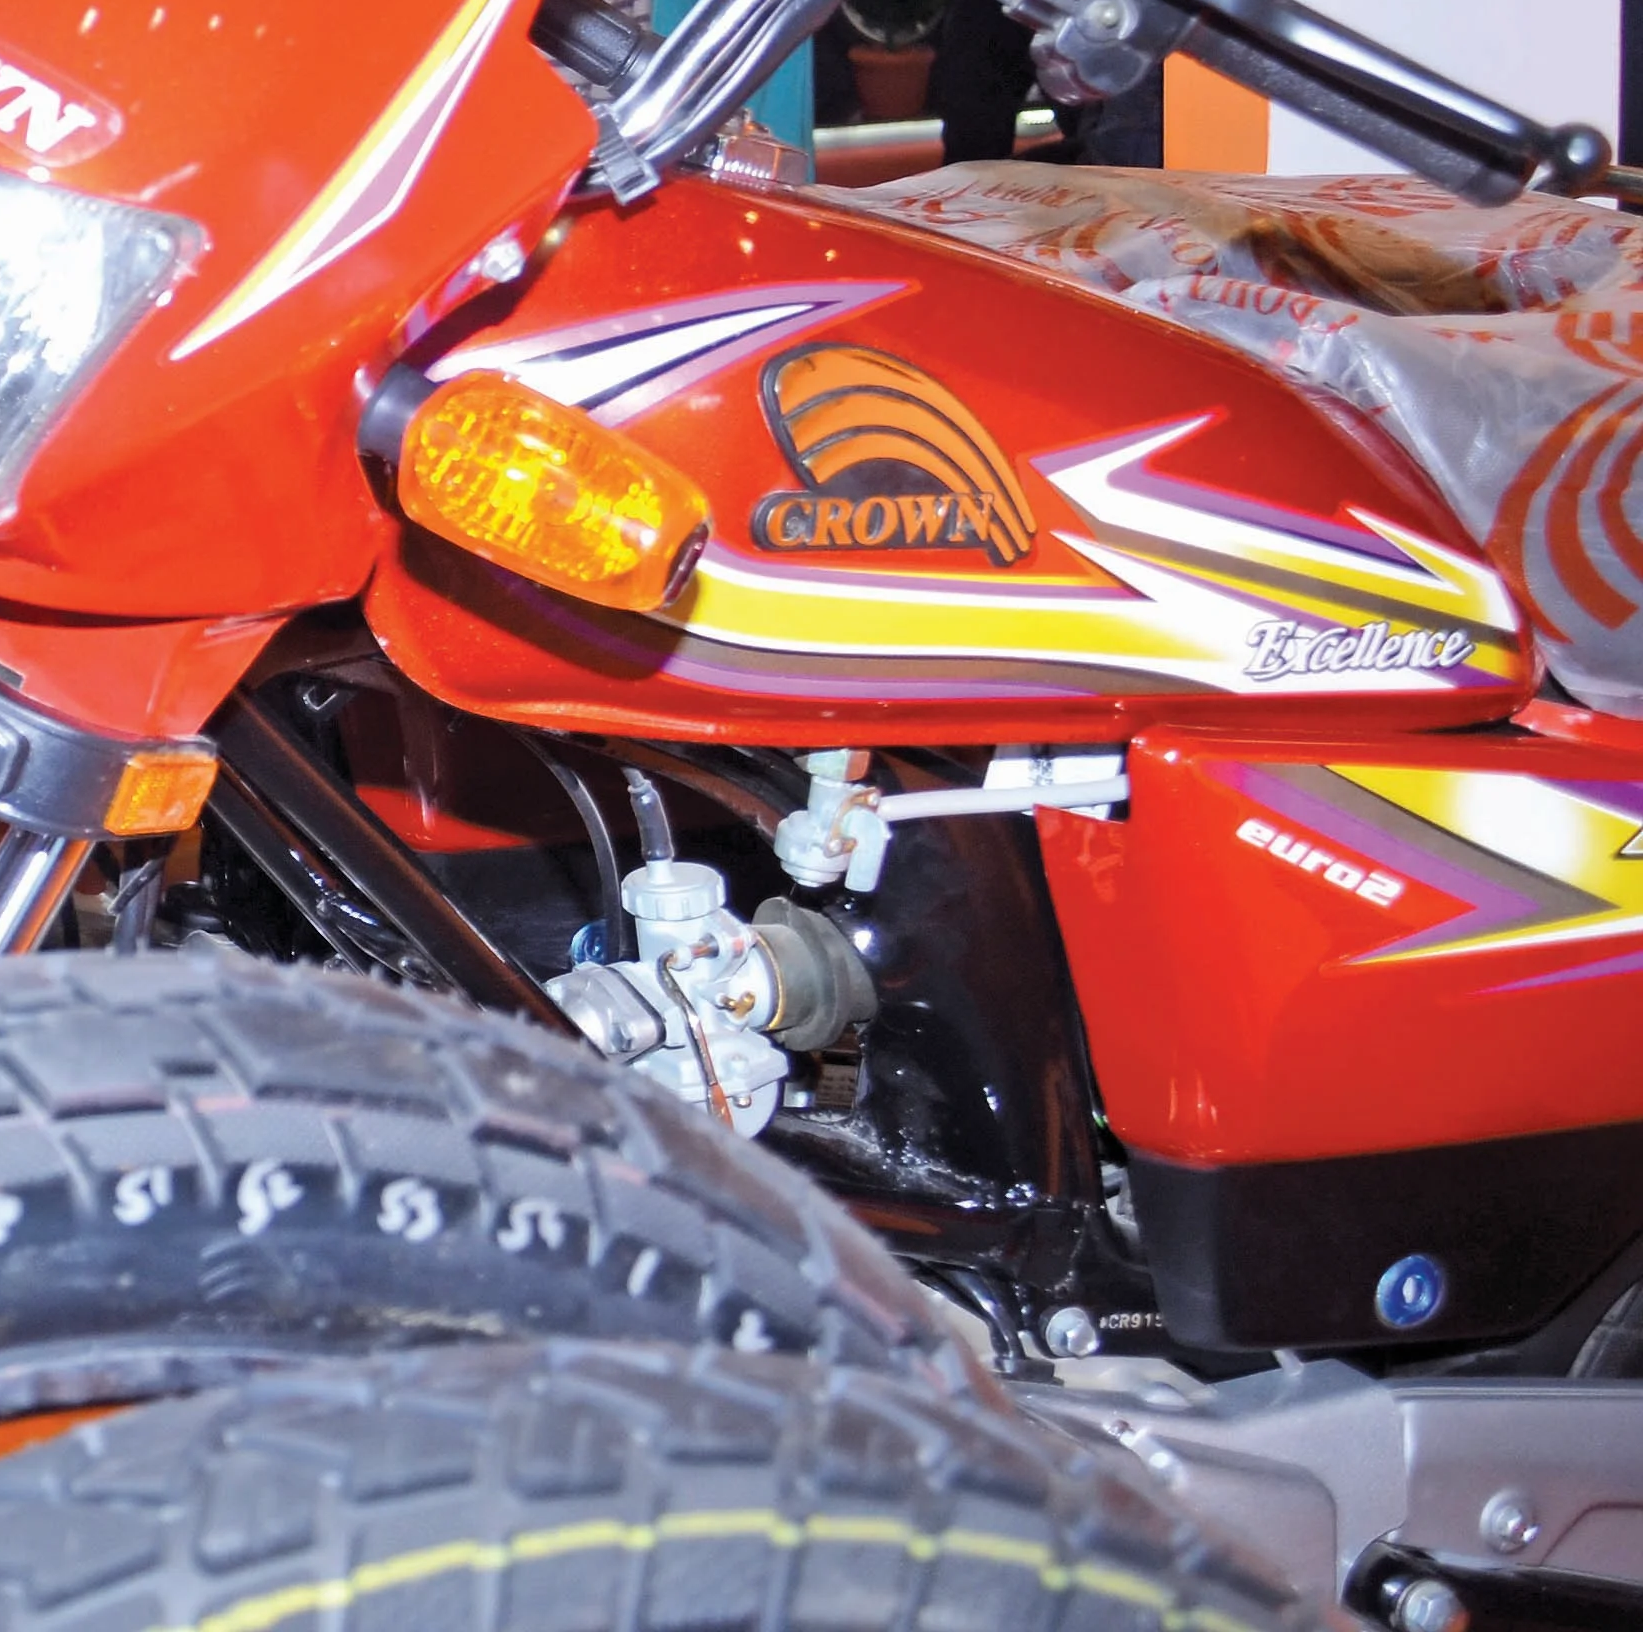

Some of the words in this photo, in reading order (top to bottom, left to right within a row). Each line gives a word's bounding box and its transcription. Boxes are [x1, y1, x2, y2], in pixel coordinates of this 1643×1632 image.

[767, 491, 995, 548] CROWN
[1242, 619, 1477, 682] Excellence
[1235, 817, 1405, 908] euro2
